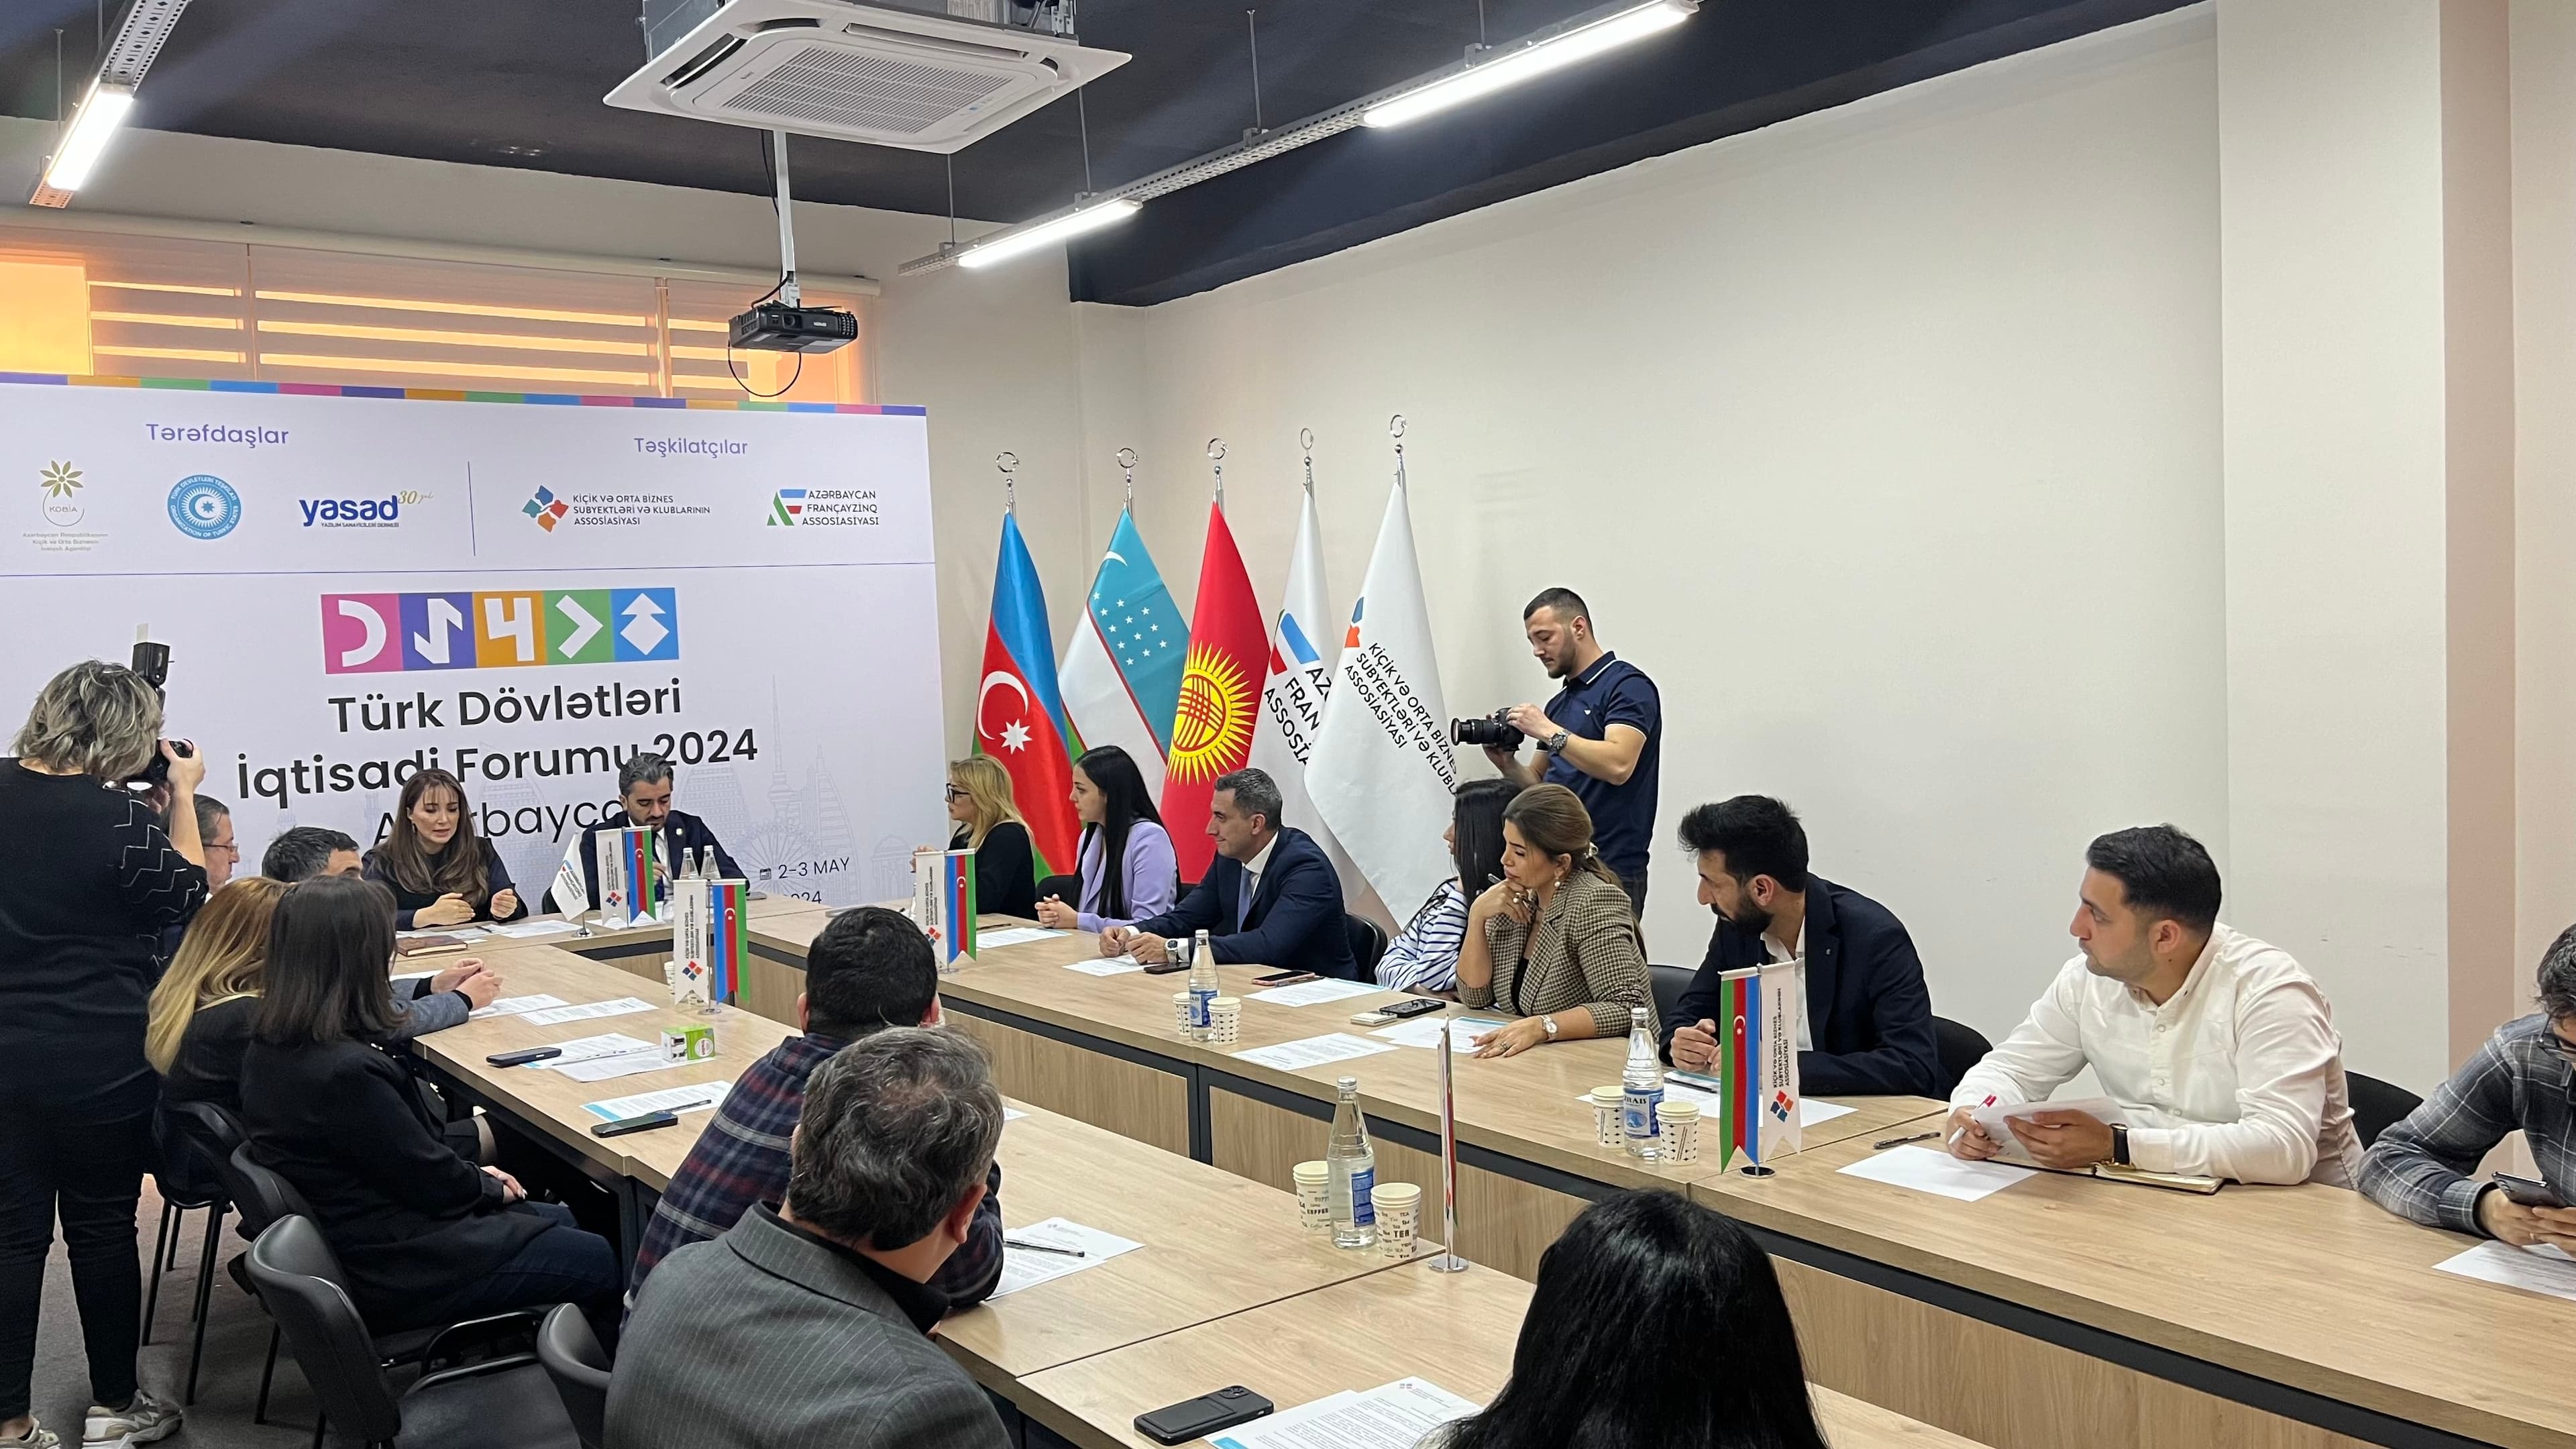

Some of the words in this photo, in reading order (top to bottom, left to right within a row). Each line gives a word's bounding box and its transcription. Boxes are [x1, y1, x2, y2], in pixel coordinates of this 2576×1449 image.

[146, 423, 289, 449] Tərəfdaşlar
[634, 437, 748, 458] Təşkilatçılar
[398, 490, 417, 504] 30
[573, 493, 598, 504] KİÇİK
[600, 495, 614, 503] VƏ
[616, 495, 640, 503] ORTA
[643, 493, 674, 503] BİZNES
[808, 490, 876, 499] AZƏRBAYCAN
[299, 495, 398, 527] yasad
[573, 504, 635, 514] SUBYEKTLƏRİ
[807, 502, 878, 515] FRANÇAYZİNQ
[574, 515, 641, 525] ASSOSİASİYASI
[1368, 643, 1397, 678] KİÇİK
[1394, 675, 1410, 696] VƏ
[1407, 696, 1434, 731] ORTA
[328, 692, 445, 733] Türk
[458, 678, 682, 726] Dövlətləri
[1344, 665, 1407, 749] ASSOSİASİYASI
[1356, 653, 1419, 733] SUBYEKTLƏRİ
[1413, 731, 1430, 751] VƏ
[1426, 751, 1456, 795] KLUBL
[653, 728, 757, 766] 2024
[814, 857, 849, 875] MAY
